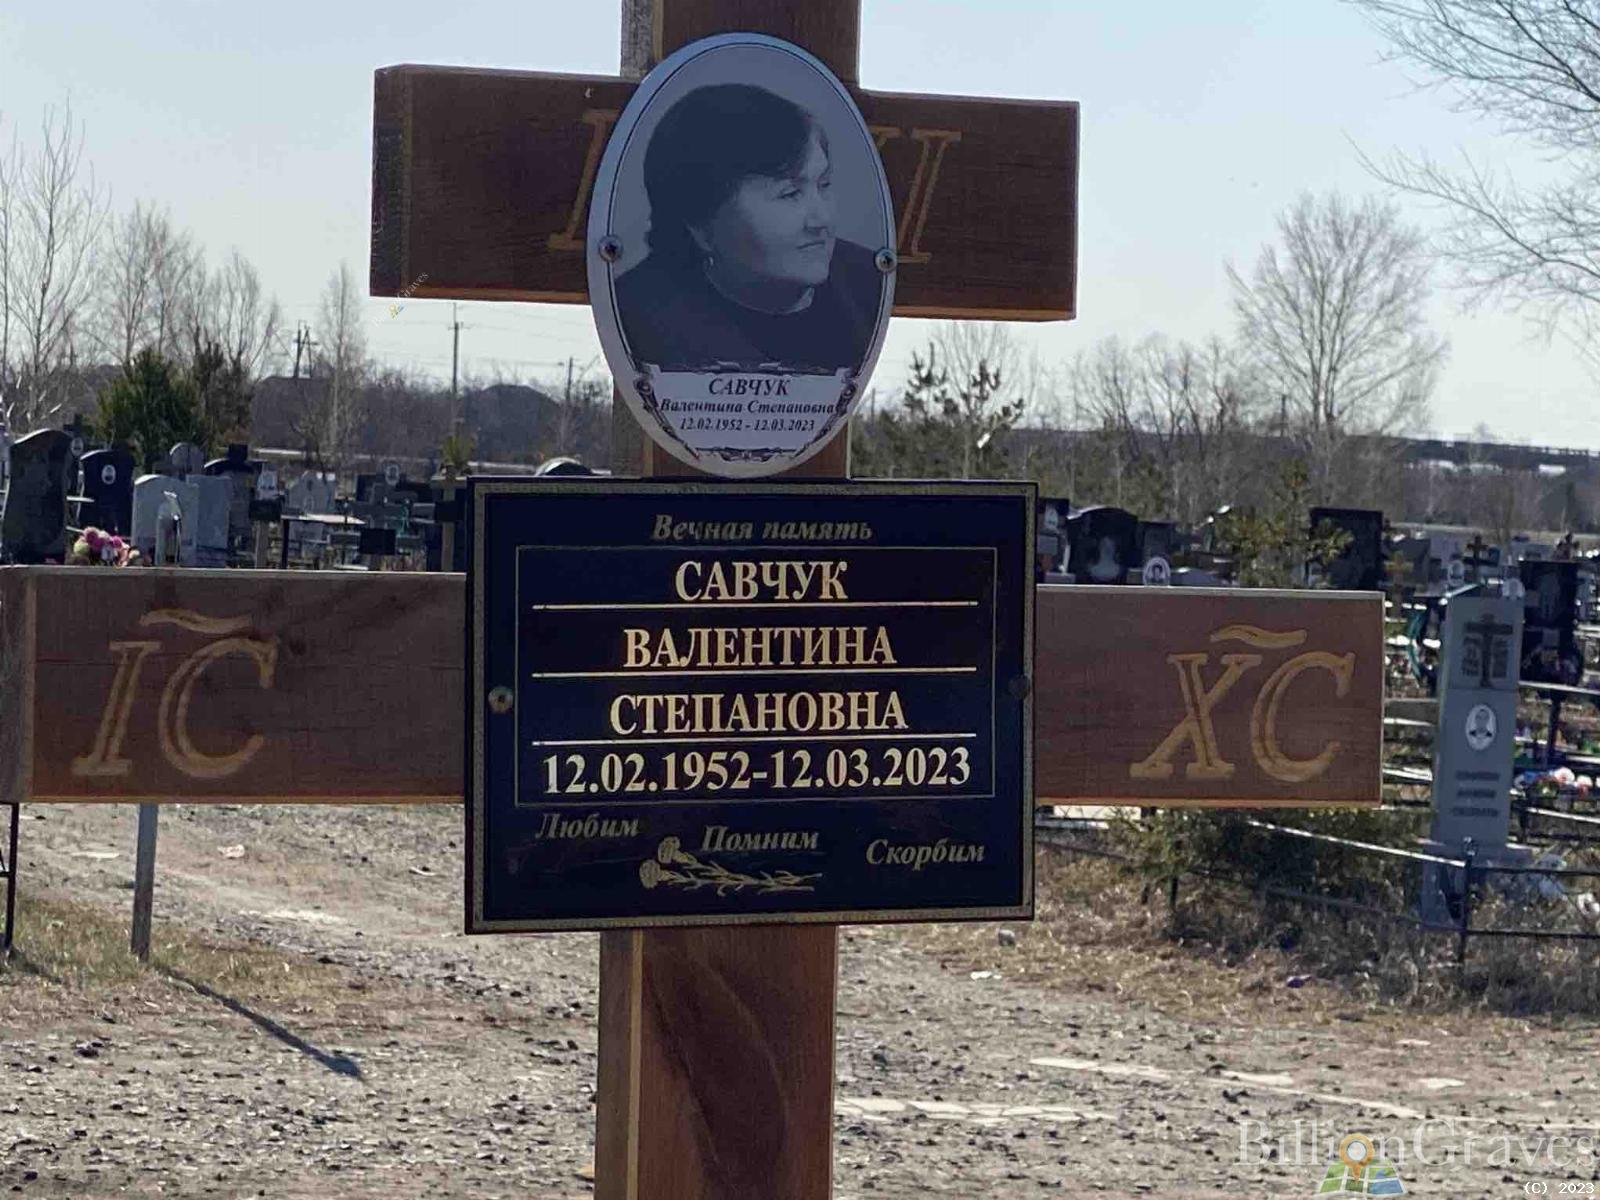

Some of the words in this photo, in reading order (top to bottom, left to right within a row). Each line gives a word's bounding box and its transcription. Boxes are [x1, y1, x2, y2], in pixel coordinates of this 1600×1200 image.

[708, 378, 791, 396] САВЧУК
[660, 399, 743, 414] Валентина
[747, 400, 836, 414] Степановна
[679, 418, 742, 431] 12.02.1952
[754, 419, 815, 432] 12.03.2023
[651, 514, 754, 541] Вечная
[761, 517, 873, 541] память
[675, 560, 849, 602] САВЧУК
[622, 625, 898, 668] ВАЛЕНТИНА
[609, 690, 909, 736] СТЕПАНОВНА
[543, 745, 971, 795] 12.02.1952-12.03.2023
[534, 812, 641, 841] Любим
[701, 826, 820, 854] Помним
[866, 838, 986, 871] Скорбим
